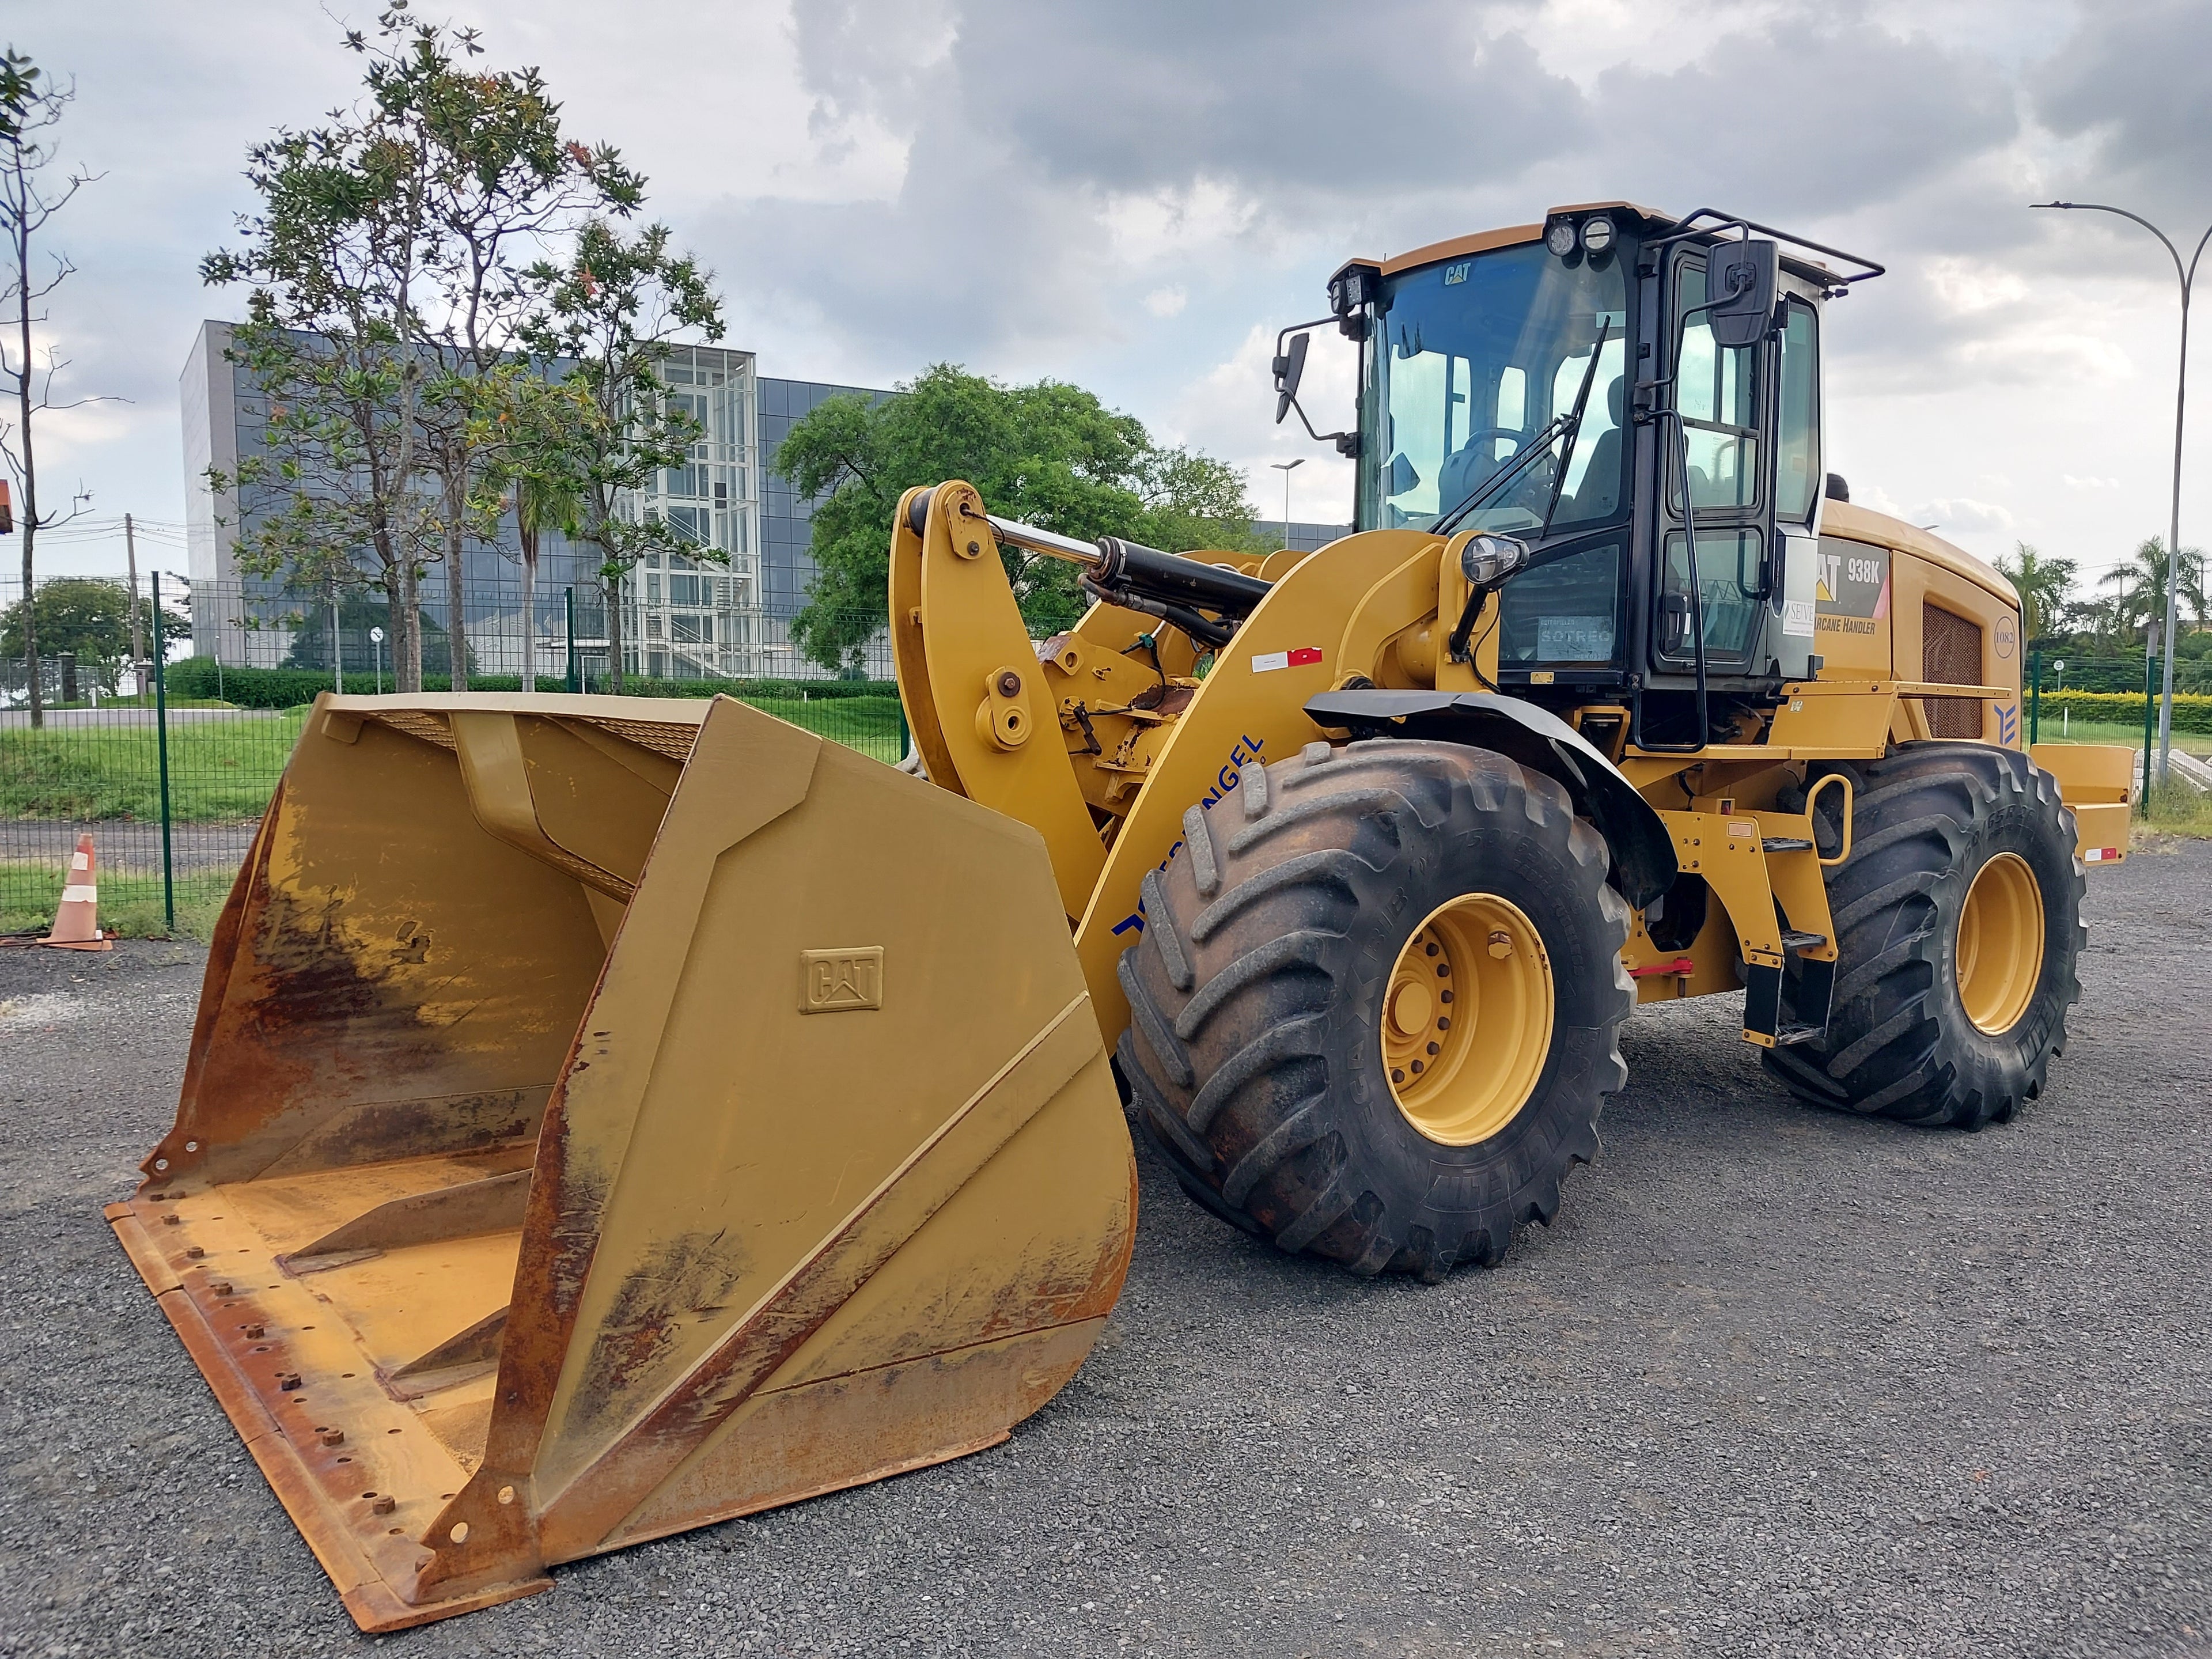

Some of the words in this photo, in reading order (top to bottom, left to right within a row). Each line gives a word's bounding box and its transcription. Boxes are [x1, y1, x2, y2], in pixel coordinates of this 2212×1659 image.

[1445, 262, 1471, 285] CAT
[1816, 554, 1841, 602] AT
[1848, 558, 1880, 584] 938K
[1843, 617, 1876, 635] HANDLER
[1995, 632, 2014, 643] 1082
[809, 959, 875, 1004] CAT
